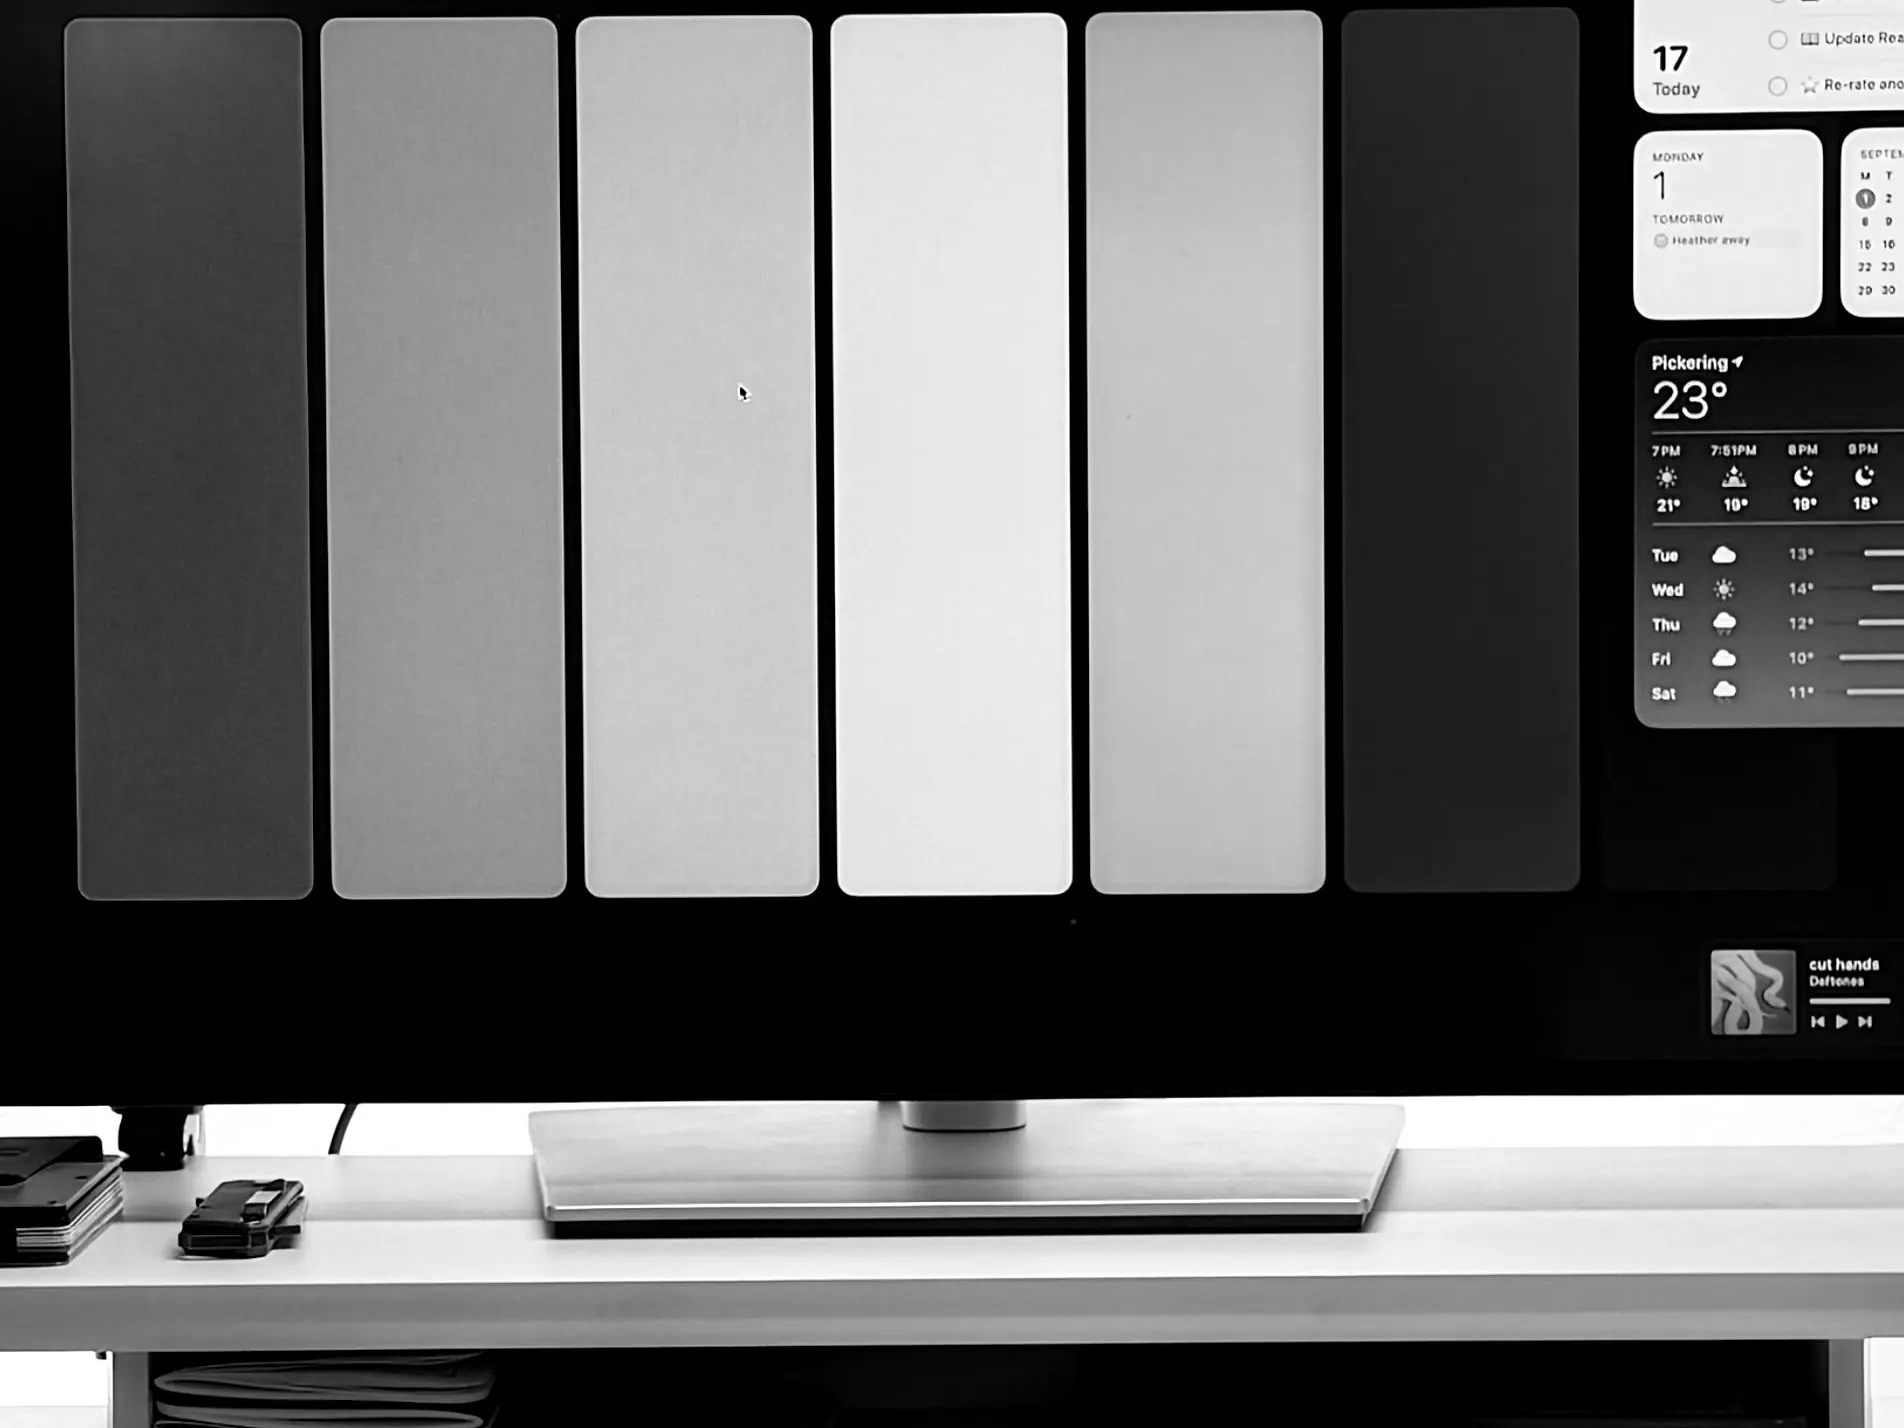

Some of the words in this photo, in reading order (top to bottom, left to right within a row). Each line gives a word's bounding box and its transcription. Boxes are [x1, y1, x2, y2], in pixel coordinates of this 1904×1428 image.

[1824, 31, 1875, 47] Update
[1652, 44, 1689, 72] 17
[1652, 82, 1701, 98] Today
[1824, 78, 1876, 92] Re-rate
[1652, 152, 1704, 162] MONDAY
[1652, 170, 1667, 200] 1
[1652, 214, 1724, 225] TOMORROW
[1651, 355, 1729, 373] Pickering
[1652, 380, 1728, 420] 23°
[1651, 548, 1679, 563] Tue
[1651, 583, 1684, 597] Wed
[1651, 618, 1680, 632] Thu
[1651, 652, 1671, 666] Fri
[1651, 686, 1676, 701] Sat
[1808, 958, 1833, 972] cut
[1835, 957, 1880, 972] hands
[1808, 974, 1865, 988] Deftones
